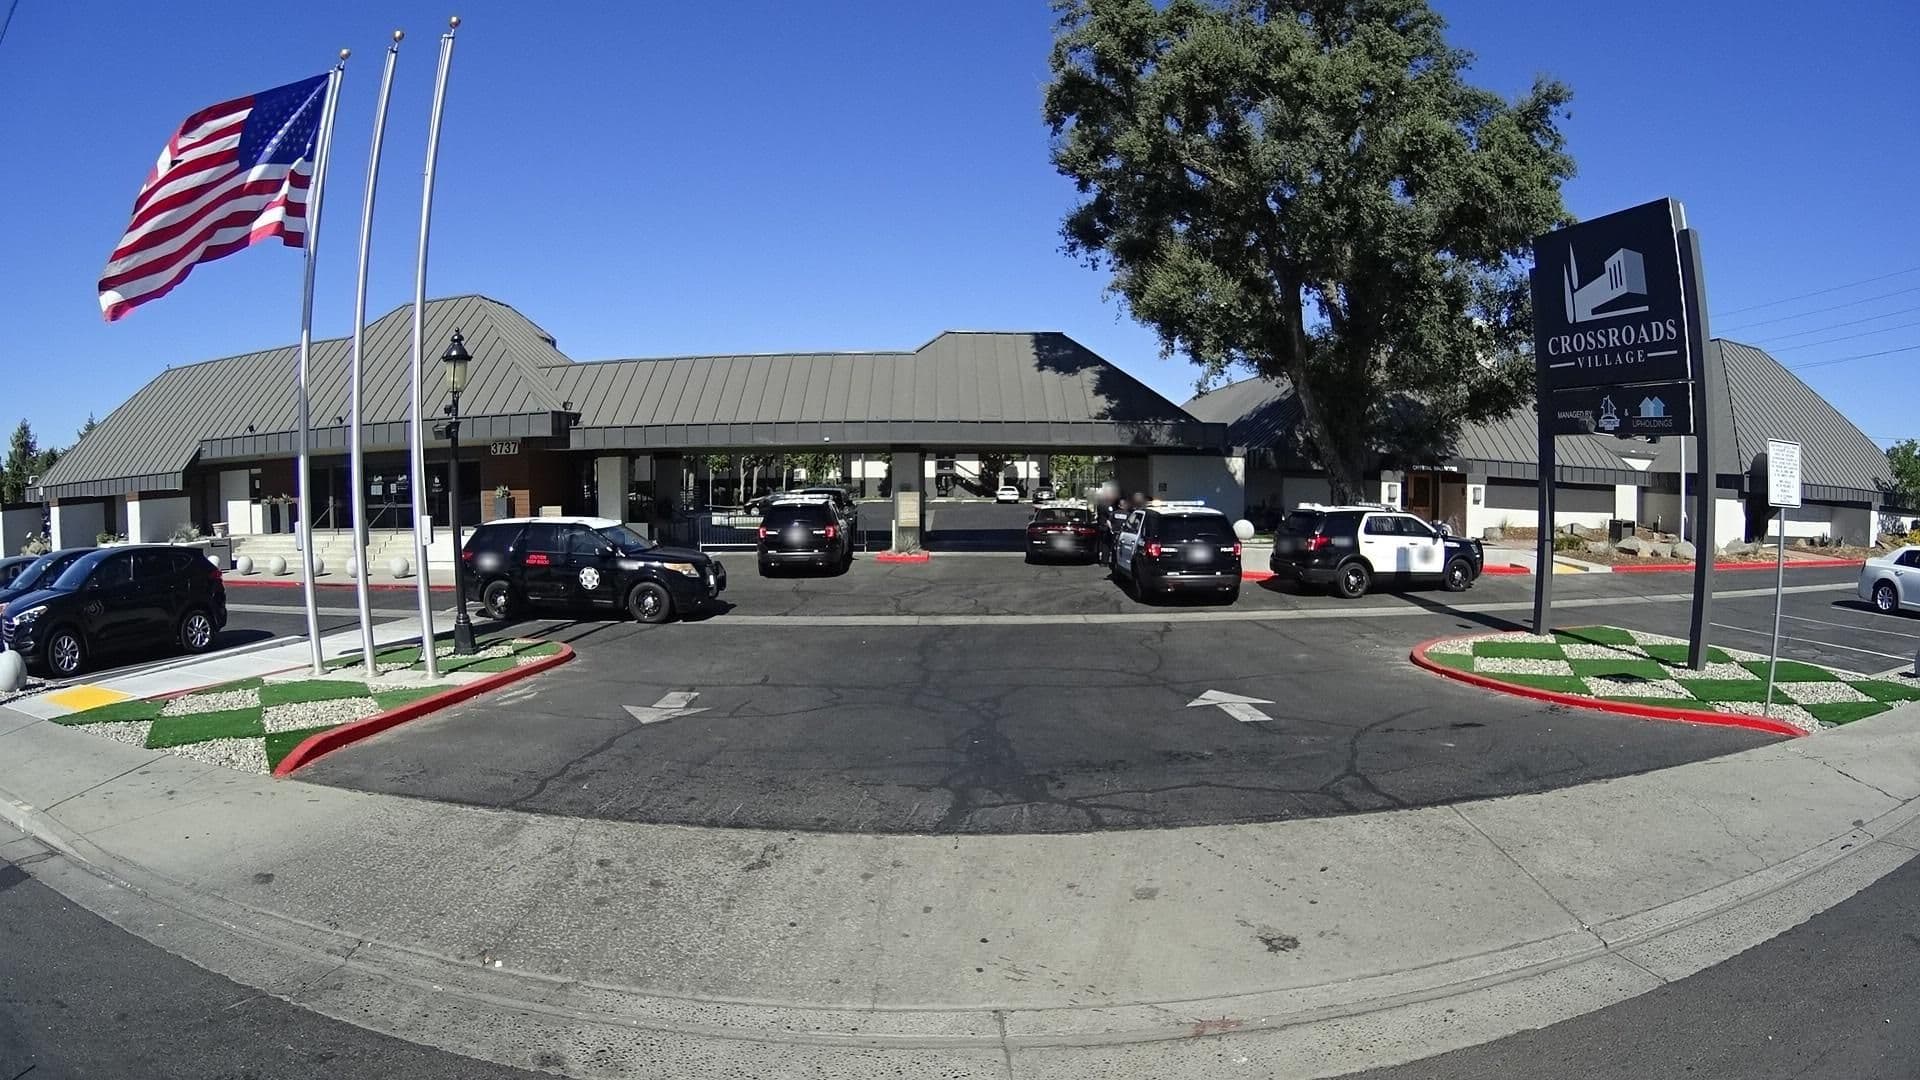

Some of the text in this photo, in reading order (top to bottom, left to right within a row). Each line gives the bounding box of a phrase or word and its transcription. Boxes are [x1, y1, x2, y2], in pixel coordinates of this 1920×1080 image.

[1548, 318, 1677, 355] CROSSROADS
[1577, 349, 1645, 368] VILLAGE
[491, 442, 518, 455] 3737
